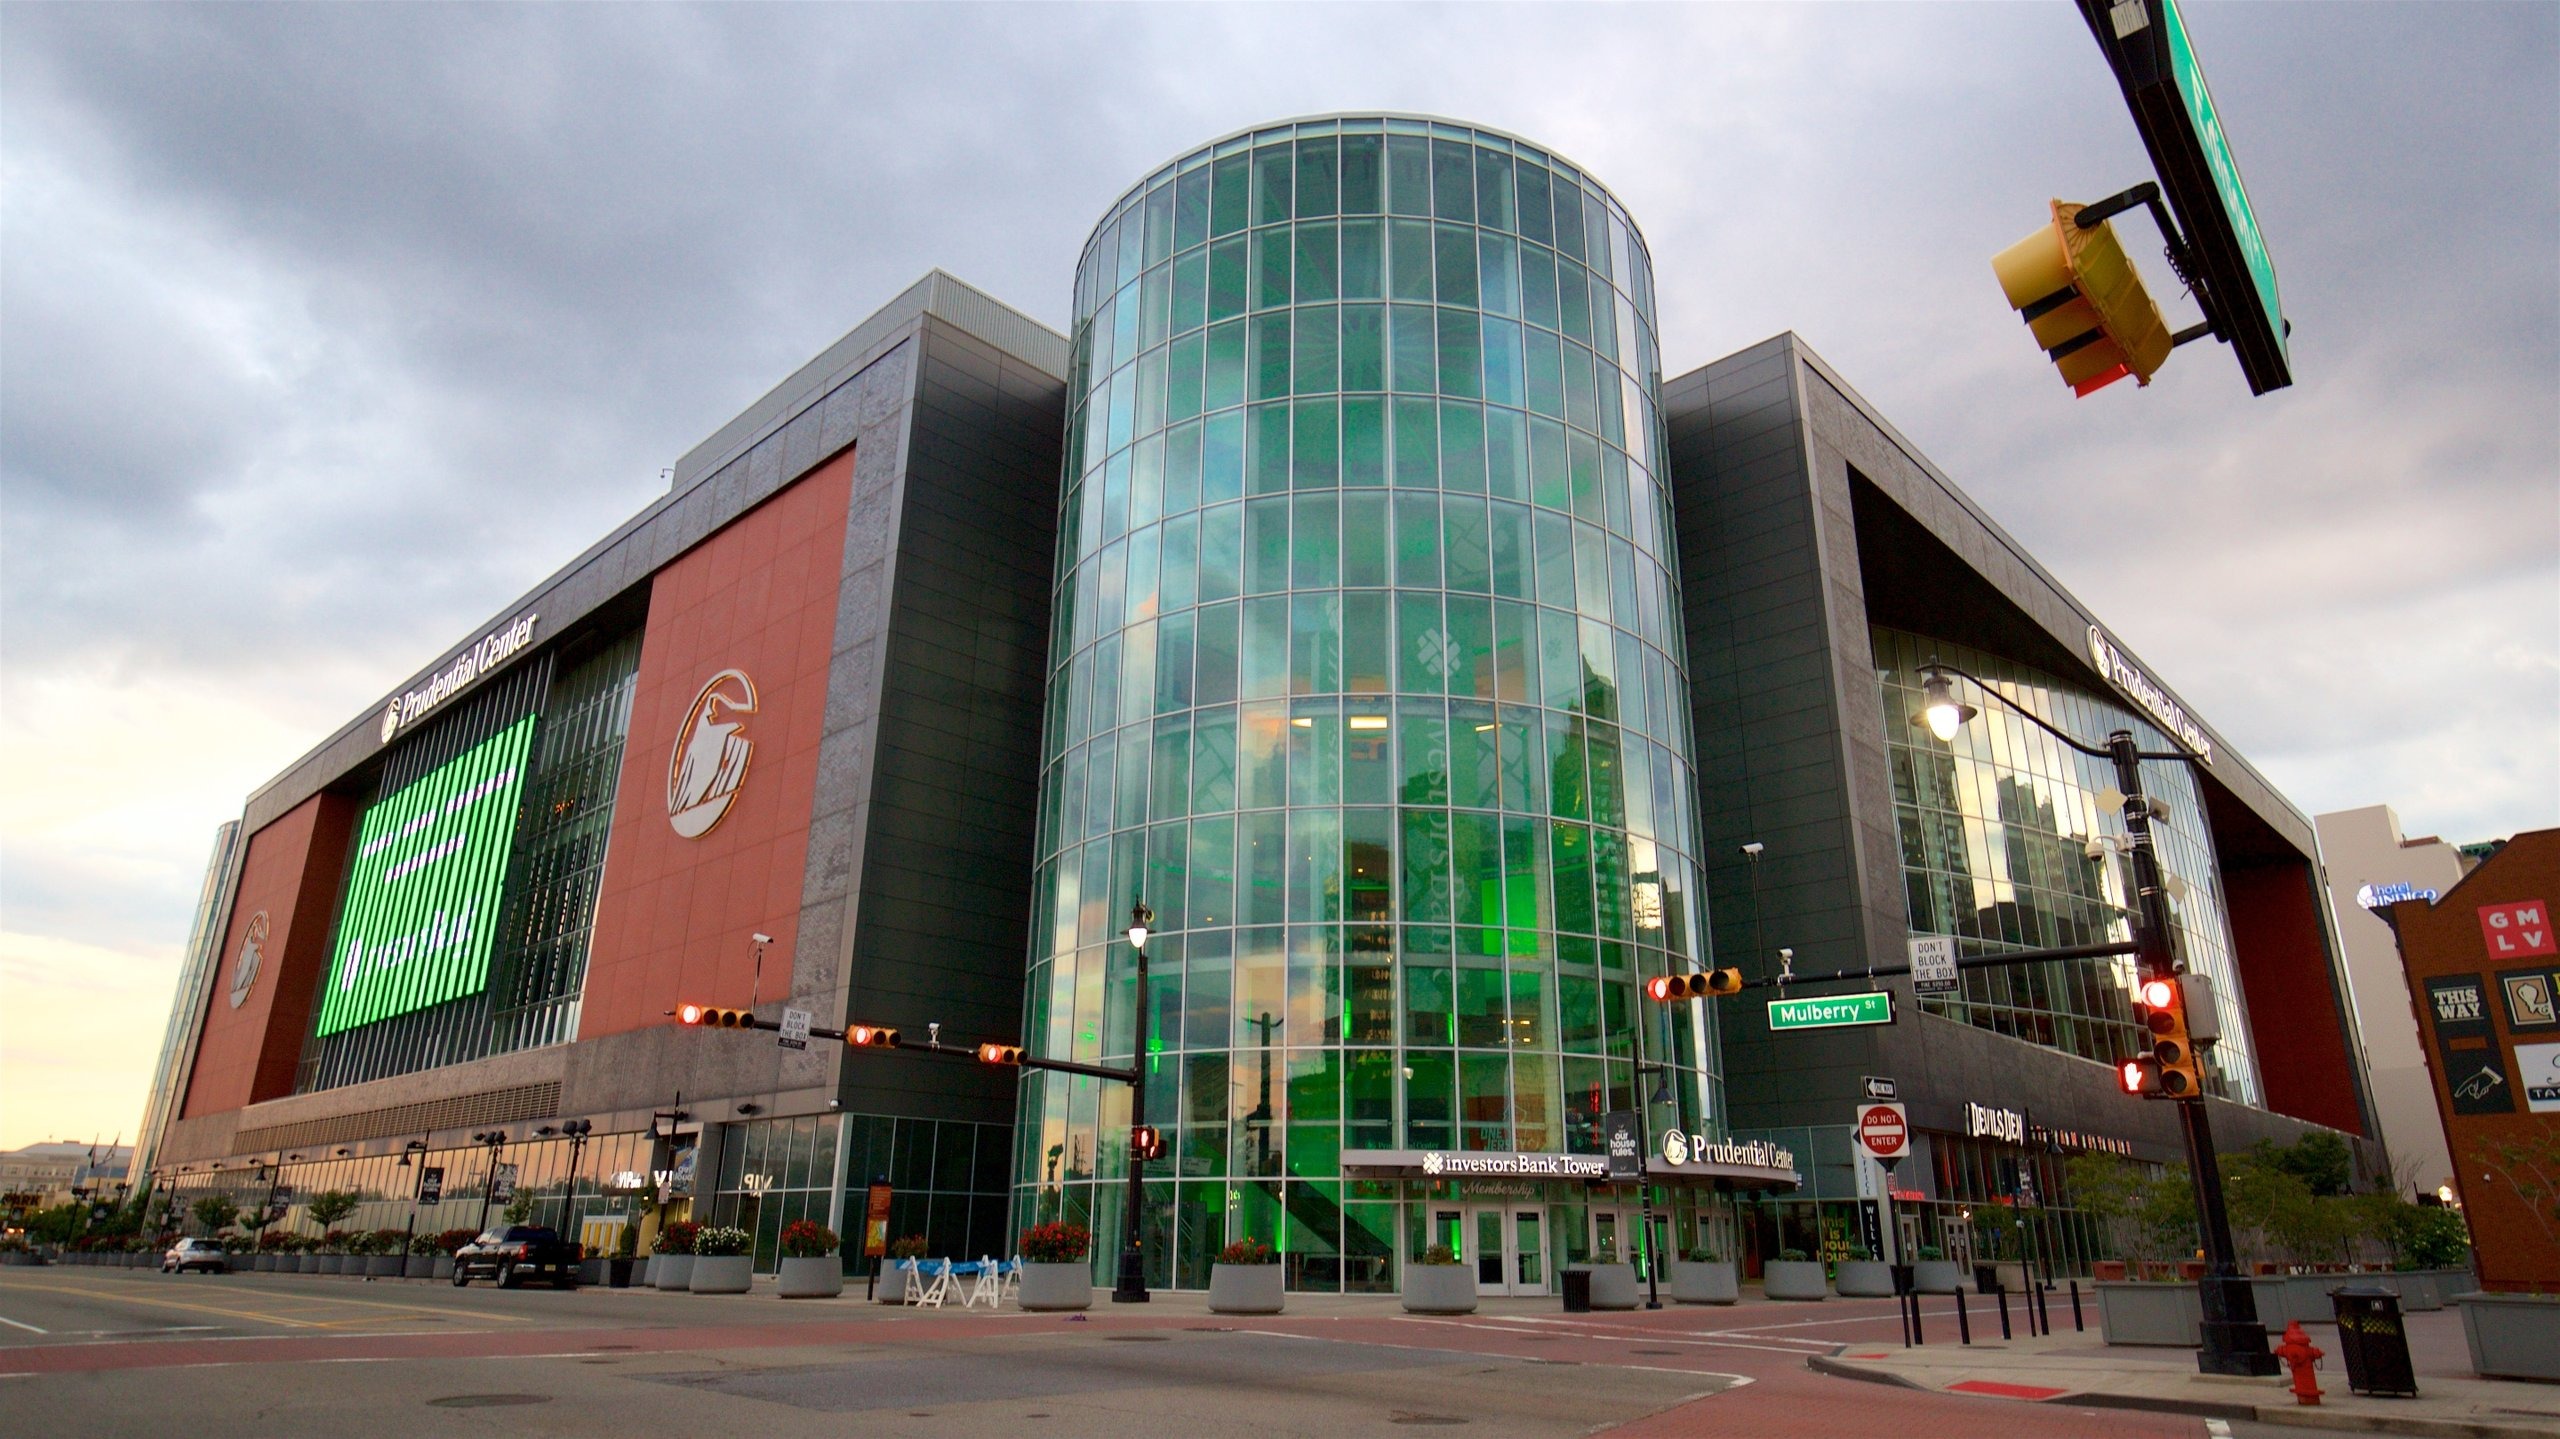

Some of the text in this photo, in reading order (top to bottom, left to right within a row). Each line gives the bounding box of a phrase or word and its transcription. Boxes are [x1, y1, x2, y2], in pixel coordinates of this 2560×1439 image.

[398, 613, 537, 729] Prudential Center
[2107, 643, 2213, 765] Prudential Center
[2376, 881, 2410, 895] hotel
[1918, 941, 1943, 953] DON'T
[1918, 956, 1947, 967] BLOCK
[1914, 967, 1954, 980] THE BOX
[2433, 988, 2479, 1006] THIS
[1780, 1000, 1876, 1023] Mulberry St
[2437, 1002, 2481, 1020] WAY
[786, 1020, 805, 1030] BLOCK
[781, 1029, 807, 1039] THE BOX
[1866, 1114, 1897, 1124] DO NOT
[1614, 1132, 1628, 1140] our
[1871, 1136, 1897, 1147] ENTER
[1610, 1139, 1636, 1148] house
[1612, 1148, 1635, 1157] rules.
[1691, 1134, 1794, 1170] Prudential Center
[1559, 1156, 1605, 1175] Tower
[1462, 1180, 1535, 1197] Membership
